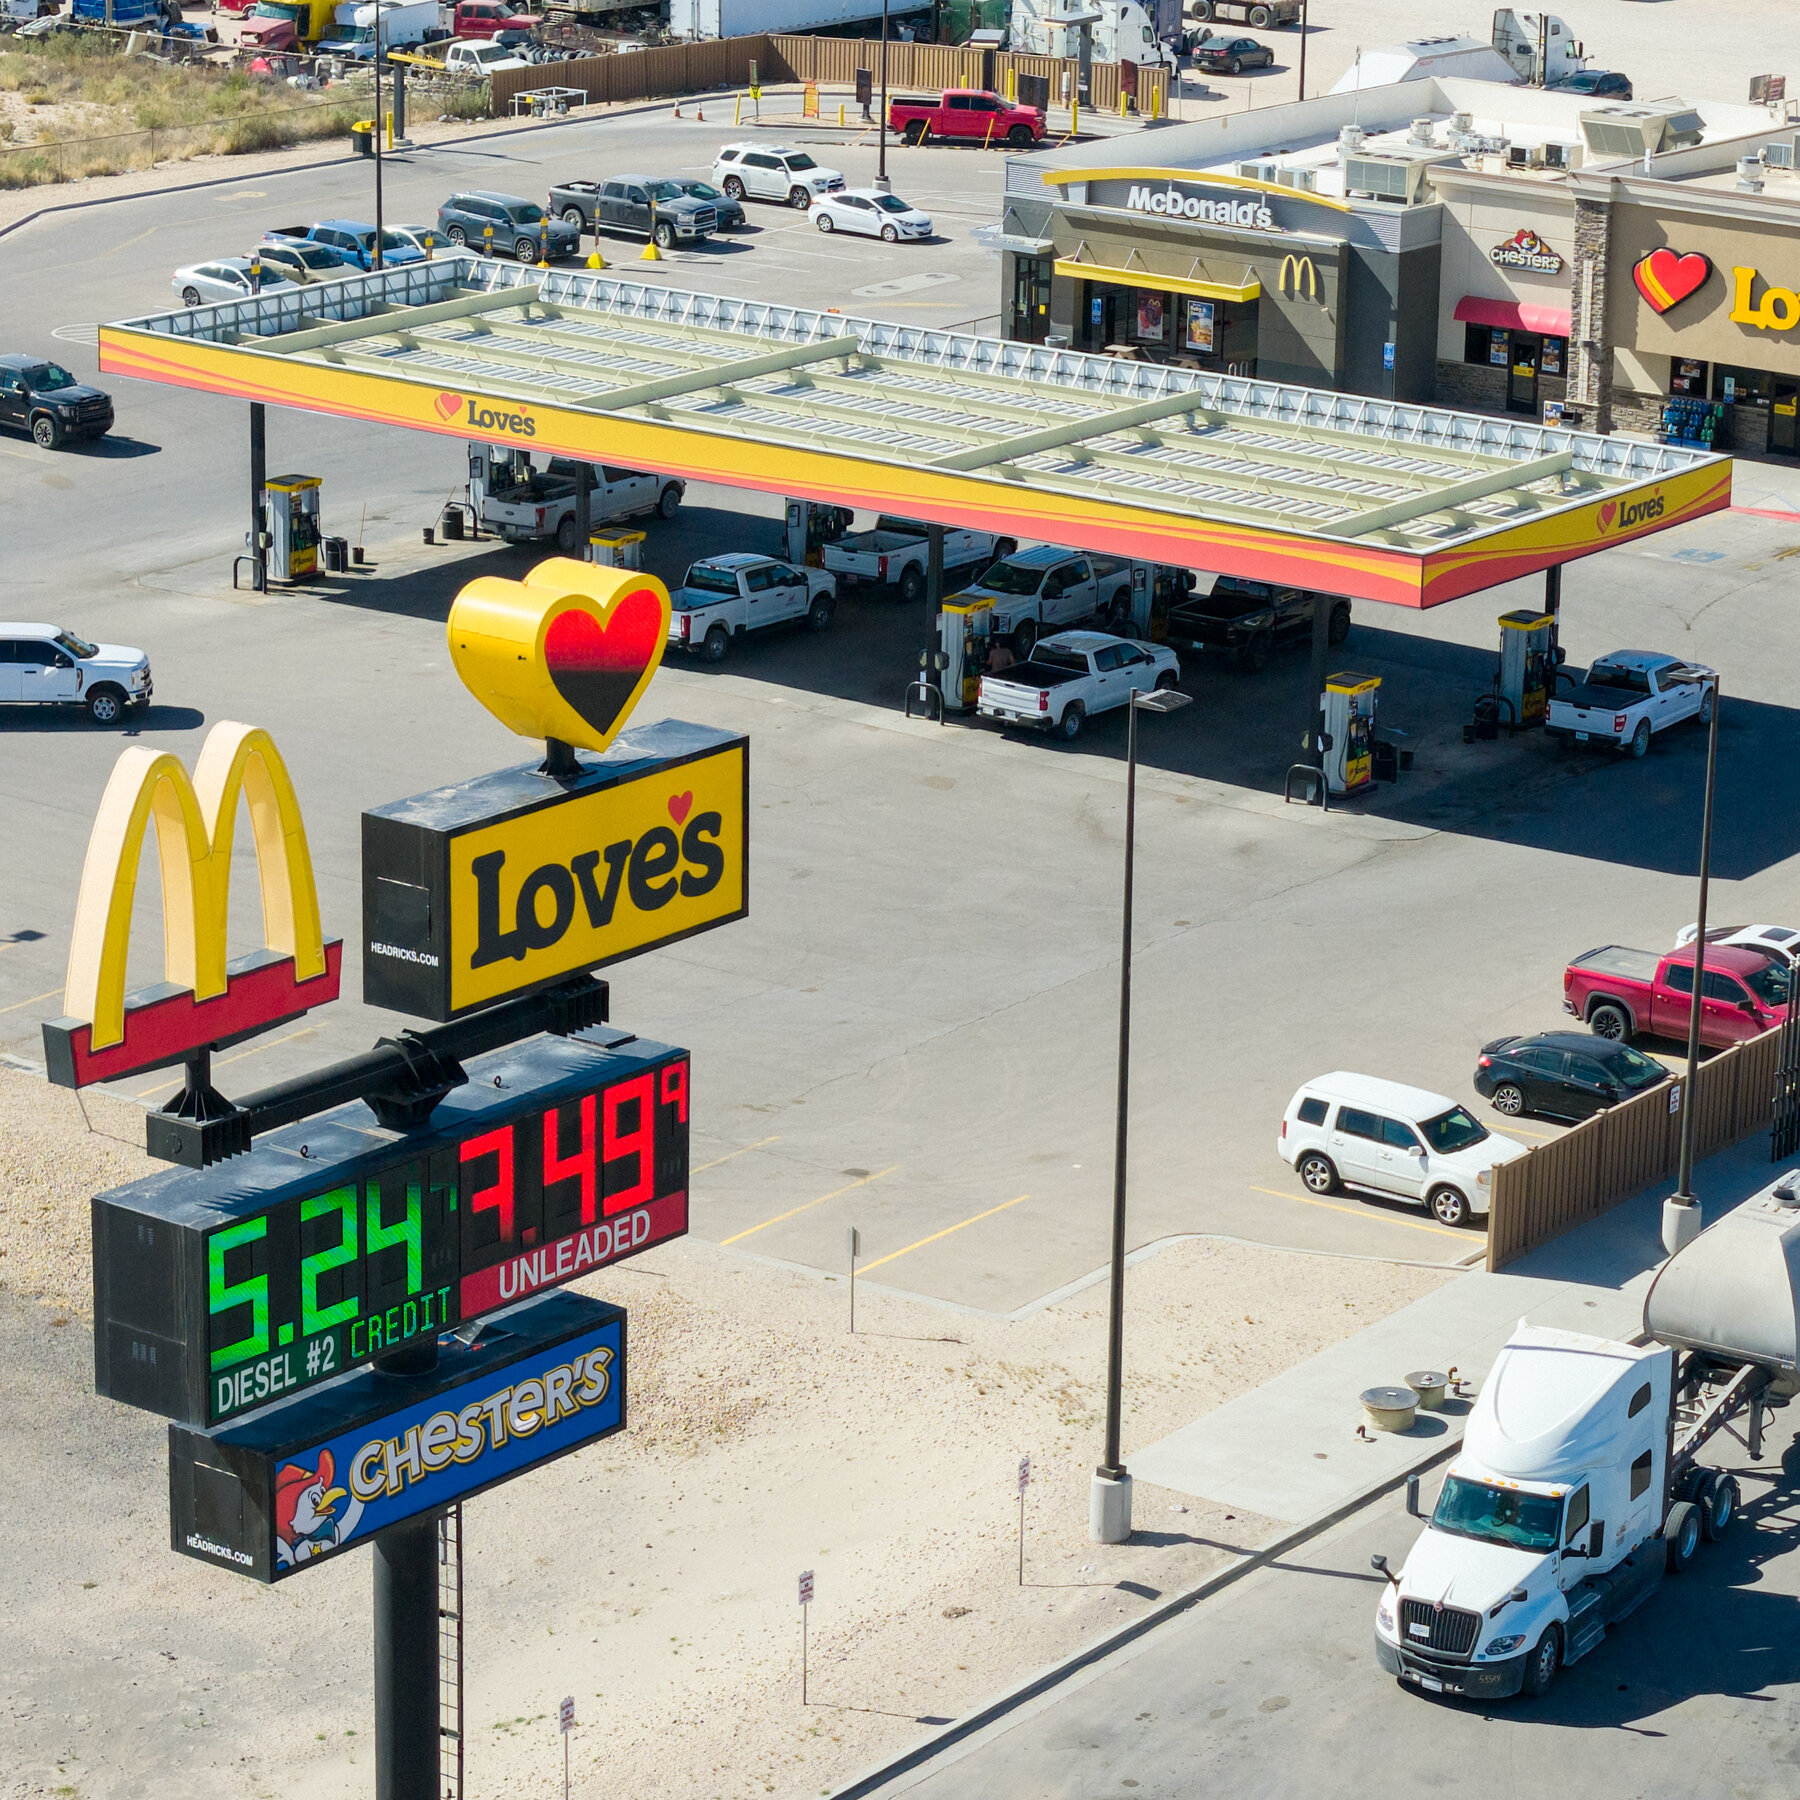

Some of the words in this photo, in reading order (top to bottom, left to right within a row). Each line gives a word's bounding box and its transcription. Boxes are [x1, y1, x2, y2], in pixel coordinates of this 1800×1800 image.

[1126, 186, 1274, 229] McDonald's
[1729, 265, 1800, 331] Lo
[370, 941, 439, 967] HEADRICKS.COM
[498, 1209, 651, 1300] UNLEADED
[350, 1286, 452, 1359] CREDIT
[218, 1353, 297, 1414] DIESEL
[306, 1335, 335, 1378] #2
[186, 1534, 254, 1567] HEADRICKS.COM
